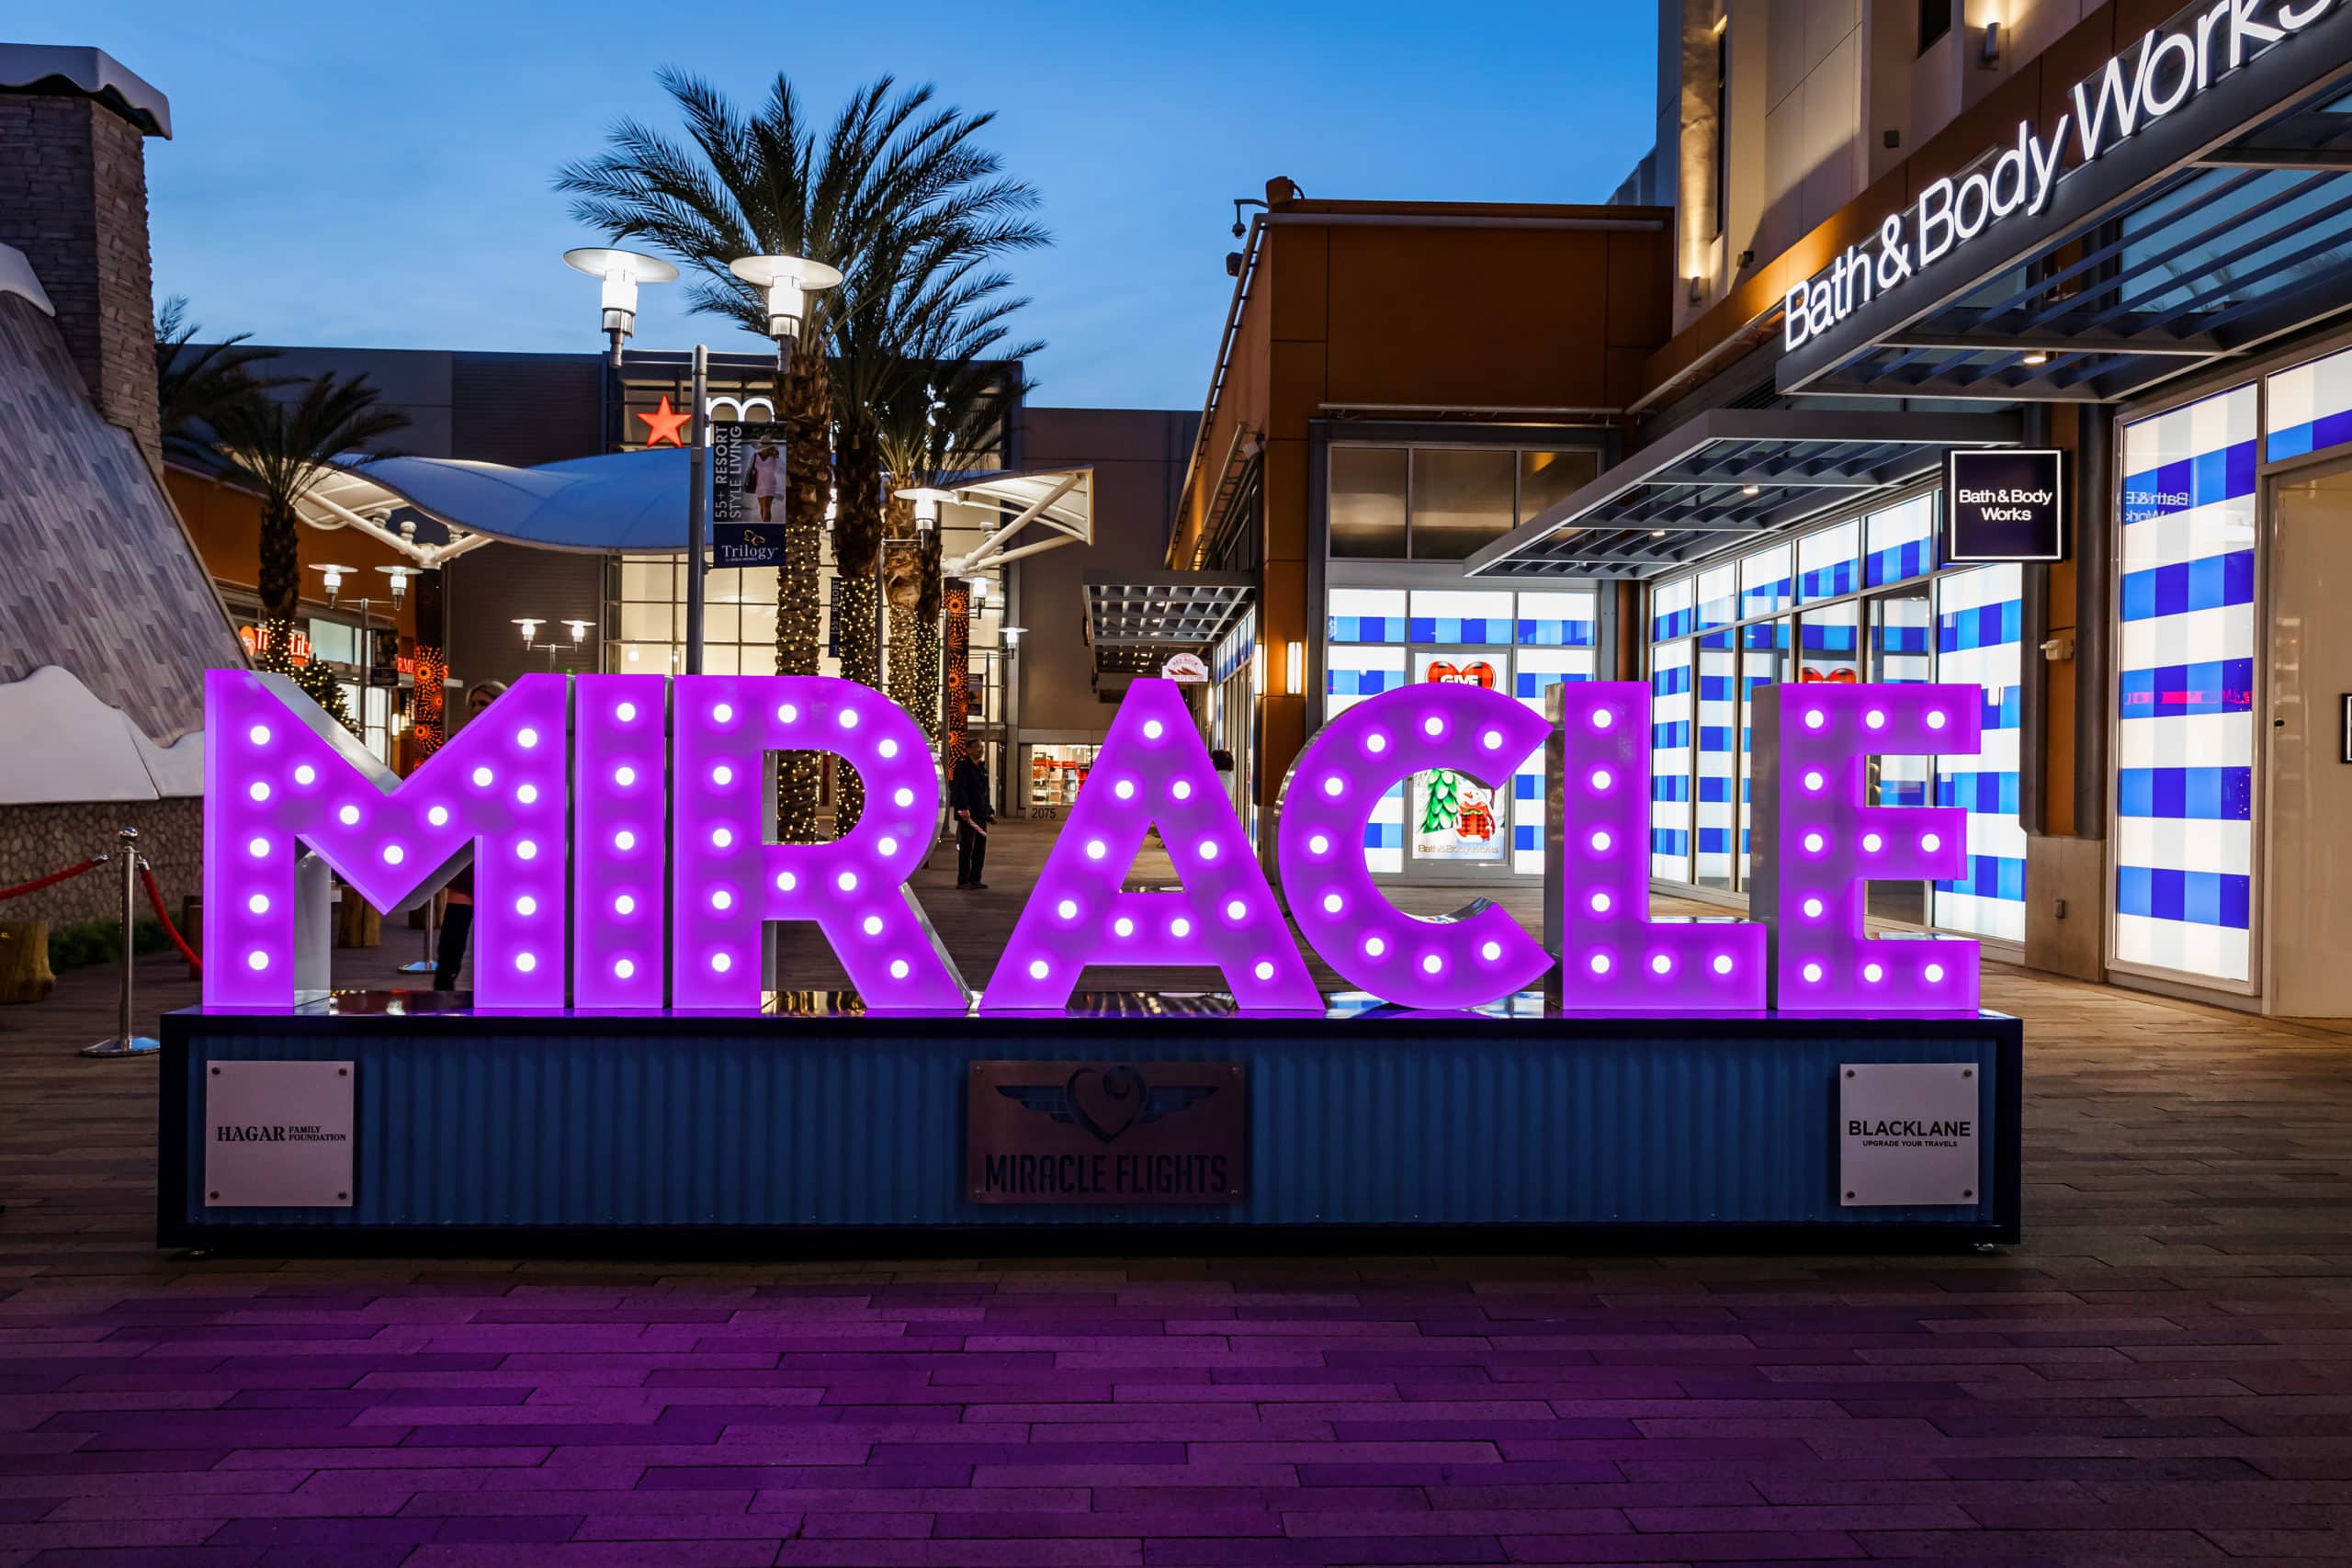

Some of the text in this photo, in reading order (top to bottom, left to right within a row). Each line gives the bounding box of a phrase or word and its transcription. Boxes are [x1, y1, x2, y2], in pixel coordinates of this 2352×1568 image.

[1784, 243, 1871, 353] Bath
[1877, 213, 1912, 289] &
[1918, 114, 2069, 217] Body
[715, 426, 728, 518] 55+ RESORT
[729, 425, 742, 518] STYLE LIVING
[1959, 489, 2052, 505] Bath & Body
[1981, 507, 2032, 521] Works
[721, 544, 775, 560] Trilogy
[1031, 807, 1057, 819] 2075
[203, 669, 1982, 1015] MIRACLE
[217, 1125, 322, 1142] HAGAR FAMILY
[1849, 1120, 1971, 1137] BLACKLANE
[288, 1134, 346, 1142] FOUNDATION
[985, 1154, 1227, 1193] MIRACLE FLIGHTS
